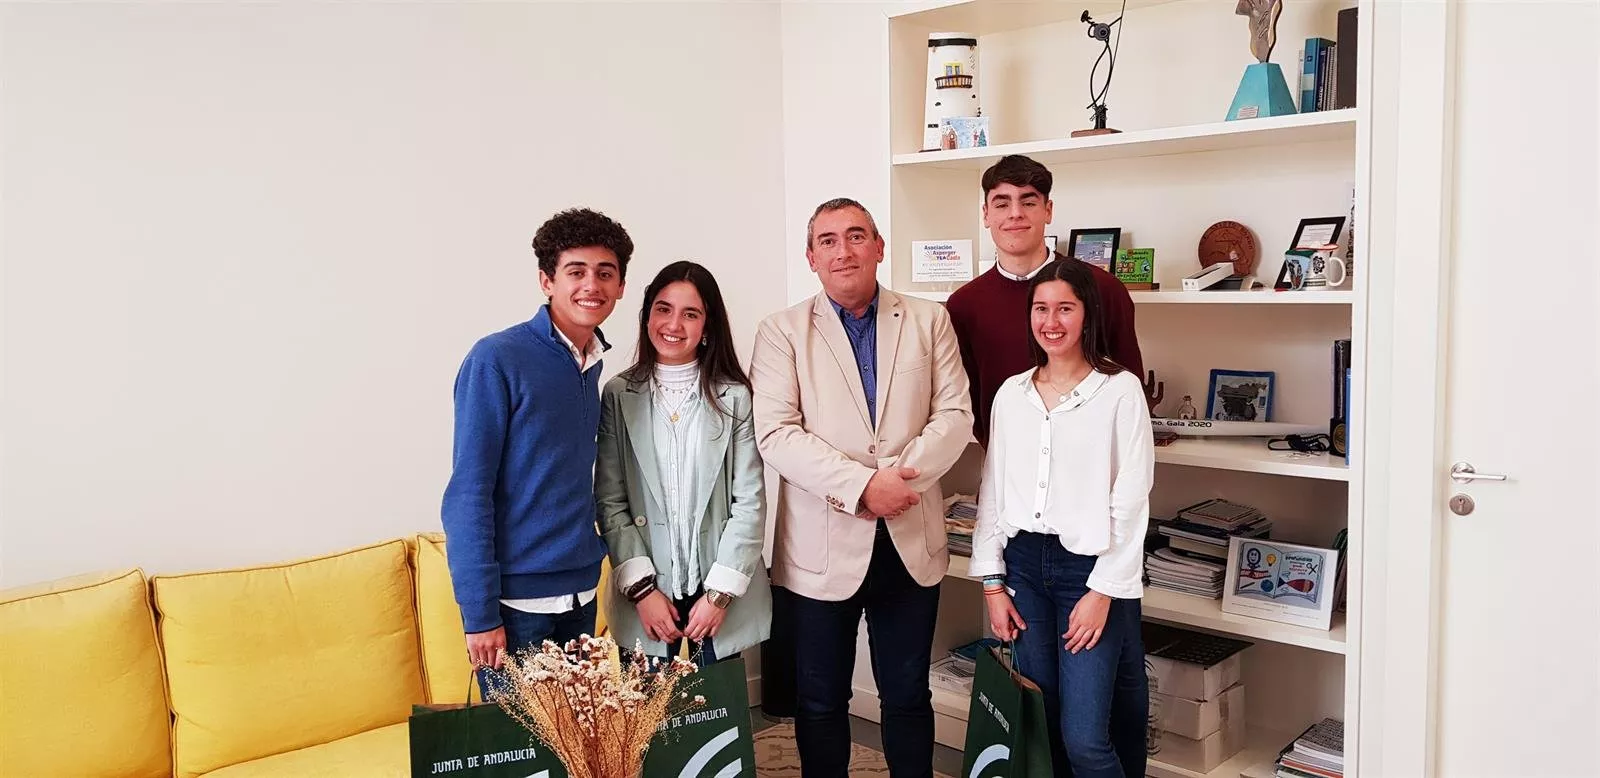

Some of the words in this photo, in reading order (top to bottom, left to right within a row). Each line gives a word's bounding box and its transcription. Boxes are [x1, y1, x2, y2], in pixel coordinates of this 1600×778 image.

[1187, 420, 1212, 428] 2020
[672, 716, 683, 729] DE
[685, 707, 728, 725] ANDALUCIA
[431, 758, 463, 774] JUNTA
[467, 756, 479, 768] DE
[484, 747, 537, 766] ANDALUCIA
